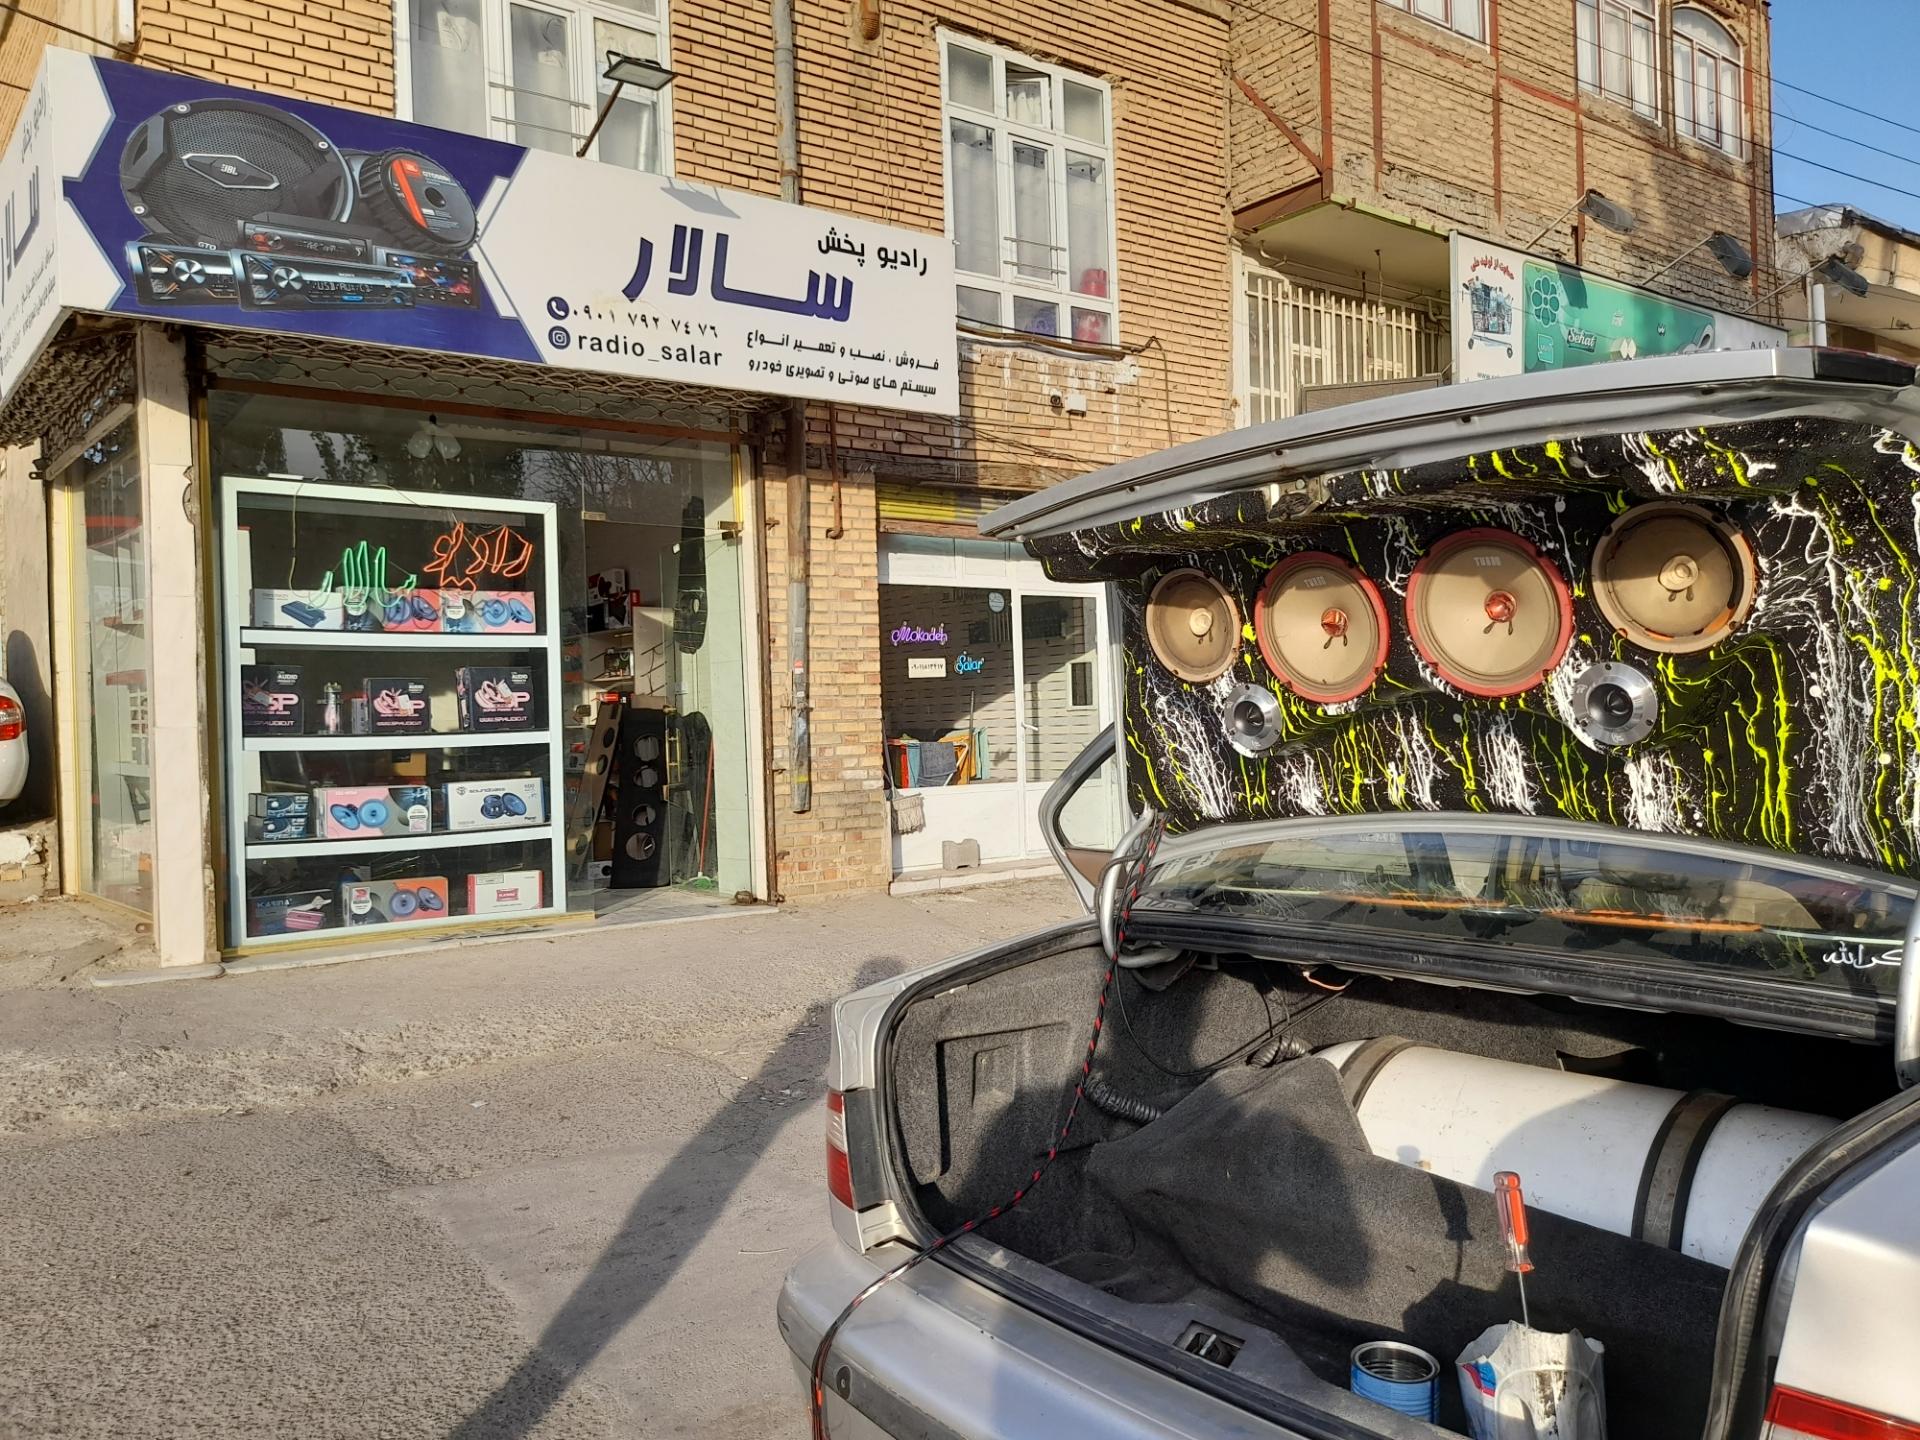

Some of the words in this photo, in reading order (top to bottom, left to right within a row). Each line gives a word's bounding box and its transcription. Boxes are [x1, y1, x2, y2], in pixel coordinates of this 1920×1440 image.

[220, 163, 238, 176] JBL
[818, 227, 866, 267] پخش
[877, 246, 928, 276] رادیو
[622, 223, 854, 322] سالار
[747, 330, 790, 348] انواع
[1567, 327, 1596, 348] Sehat
[578, 334, 723, 366] radio_salar
[793, 339, 836, 354] تعمیر
[839, 346, 846, 358] و
[849, 347, 886, 362] نصب
[748, 359, 783, 373] خودرو
[785, 364, 826, 380] تصویری
[828, 371, 835, 382] و
[838, 370, 870, 386] صوتی
[873, 375, 898, 390] های
[899, 379, 937, 398] سیستم
[423, 521, 533, 594] رادیو
